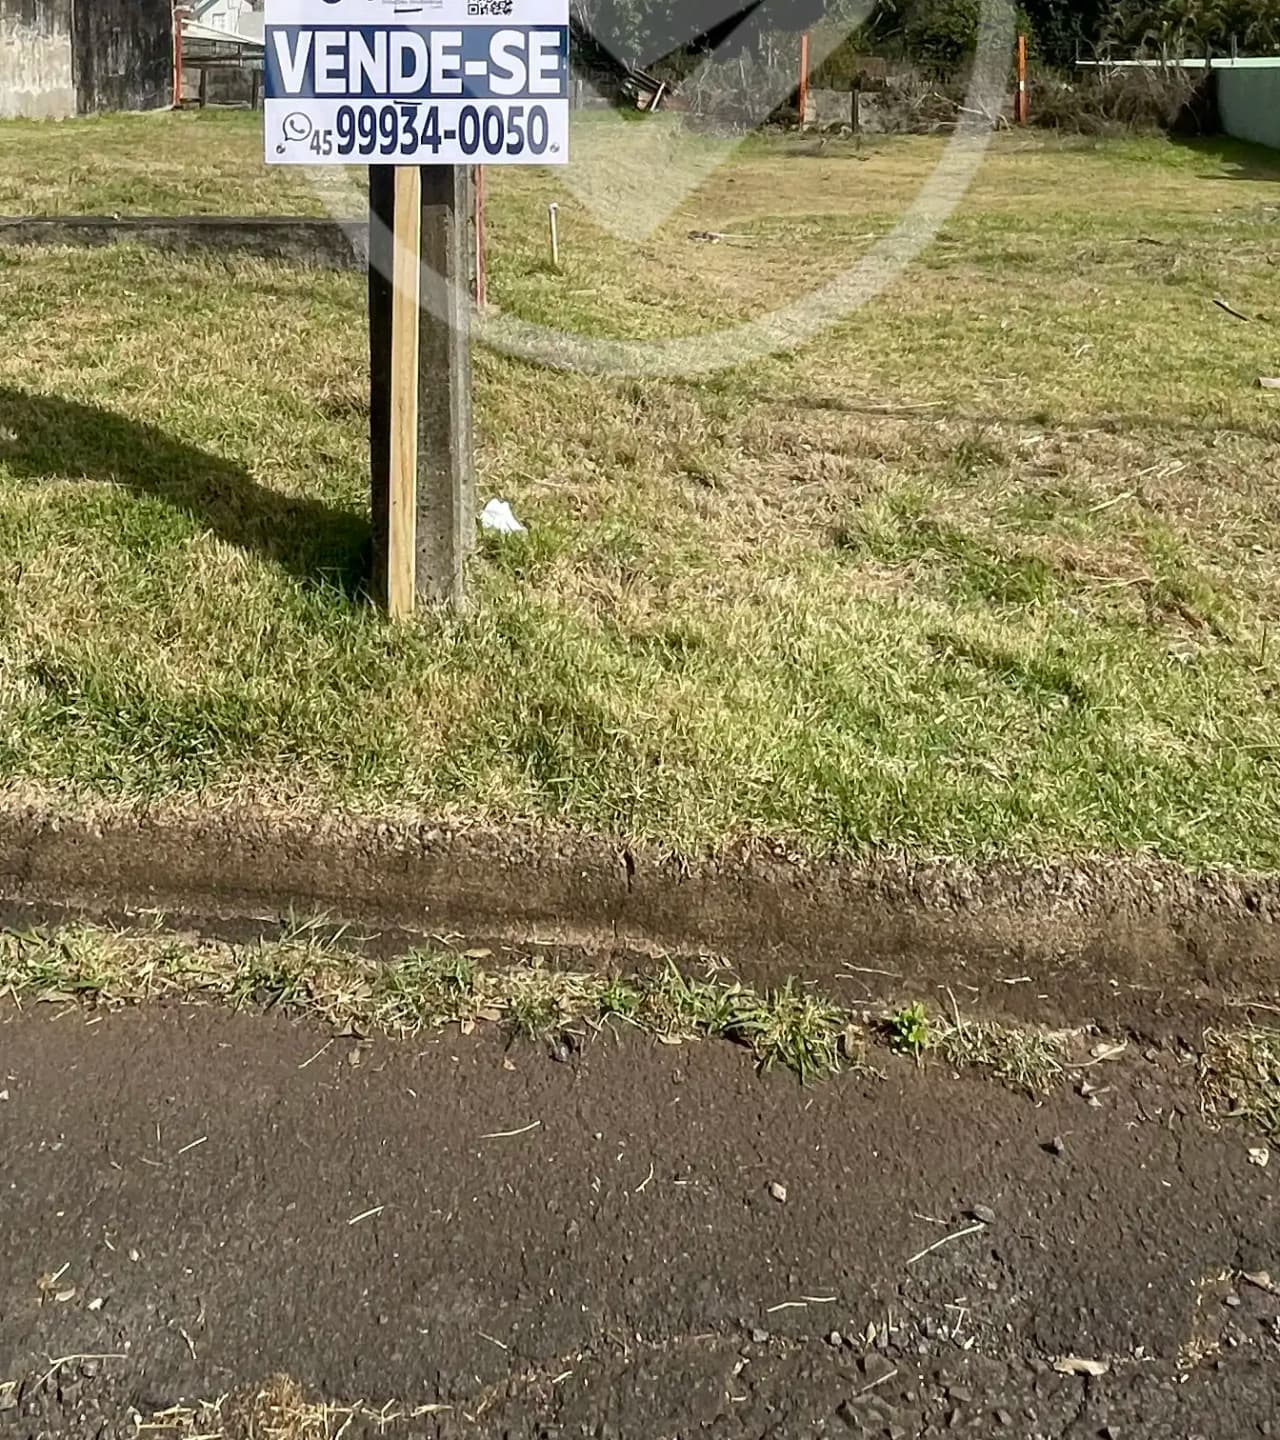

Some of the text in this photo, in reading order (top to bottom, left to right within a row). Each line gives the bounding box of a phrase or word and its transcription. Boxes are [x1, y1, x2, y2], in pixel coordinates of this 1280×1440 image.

[272, 29, 561, 96] VENDE-SE
[310, 104, 549, 156] 45 99934-0050
